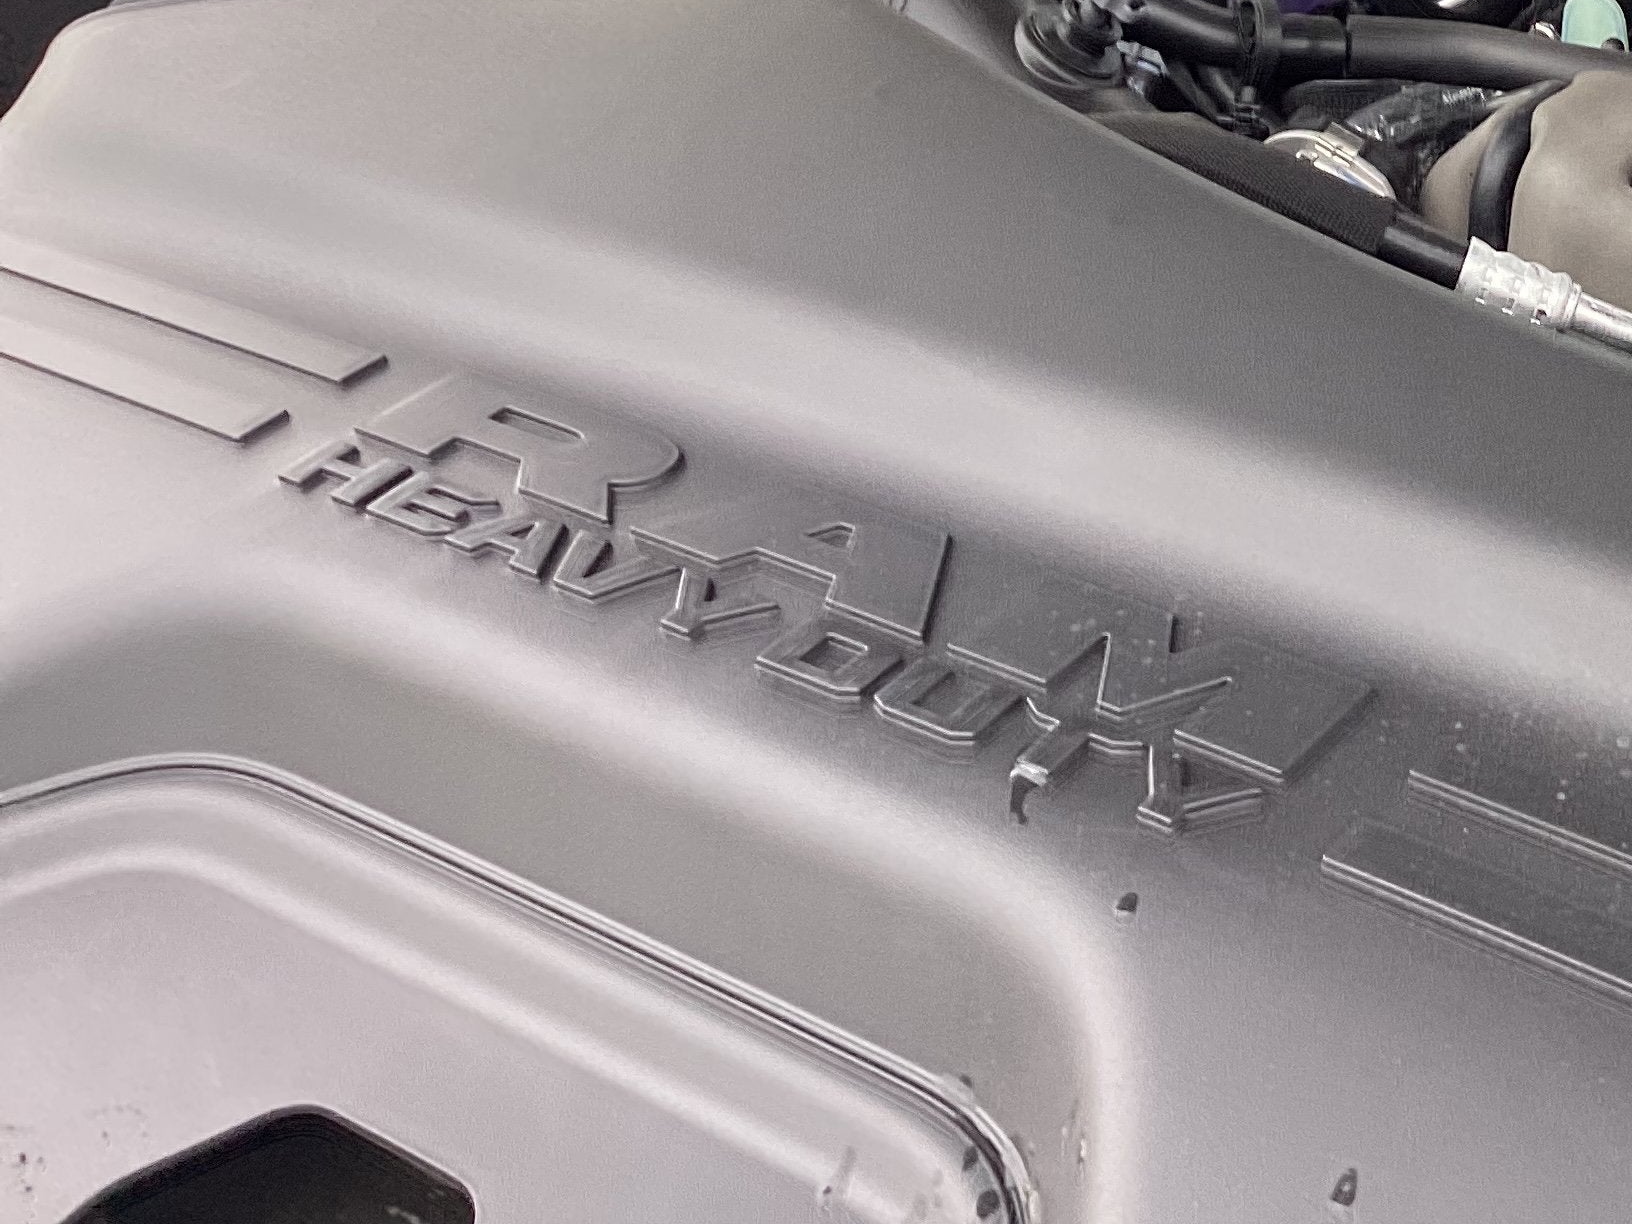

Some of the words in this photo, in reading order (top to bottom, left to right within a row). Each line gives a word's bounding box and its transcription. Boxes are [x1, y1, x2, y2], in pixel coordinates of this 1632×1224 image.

[278, 441, 779, 638] HEAVY
[755, 629, 1264, 832] DUTY
[351, 373, 1379, 782] RAM
